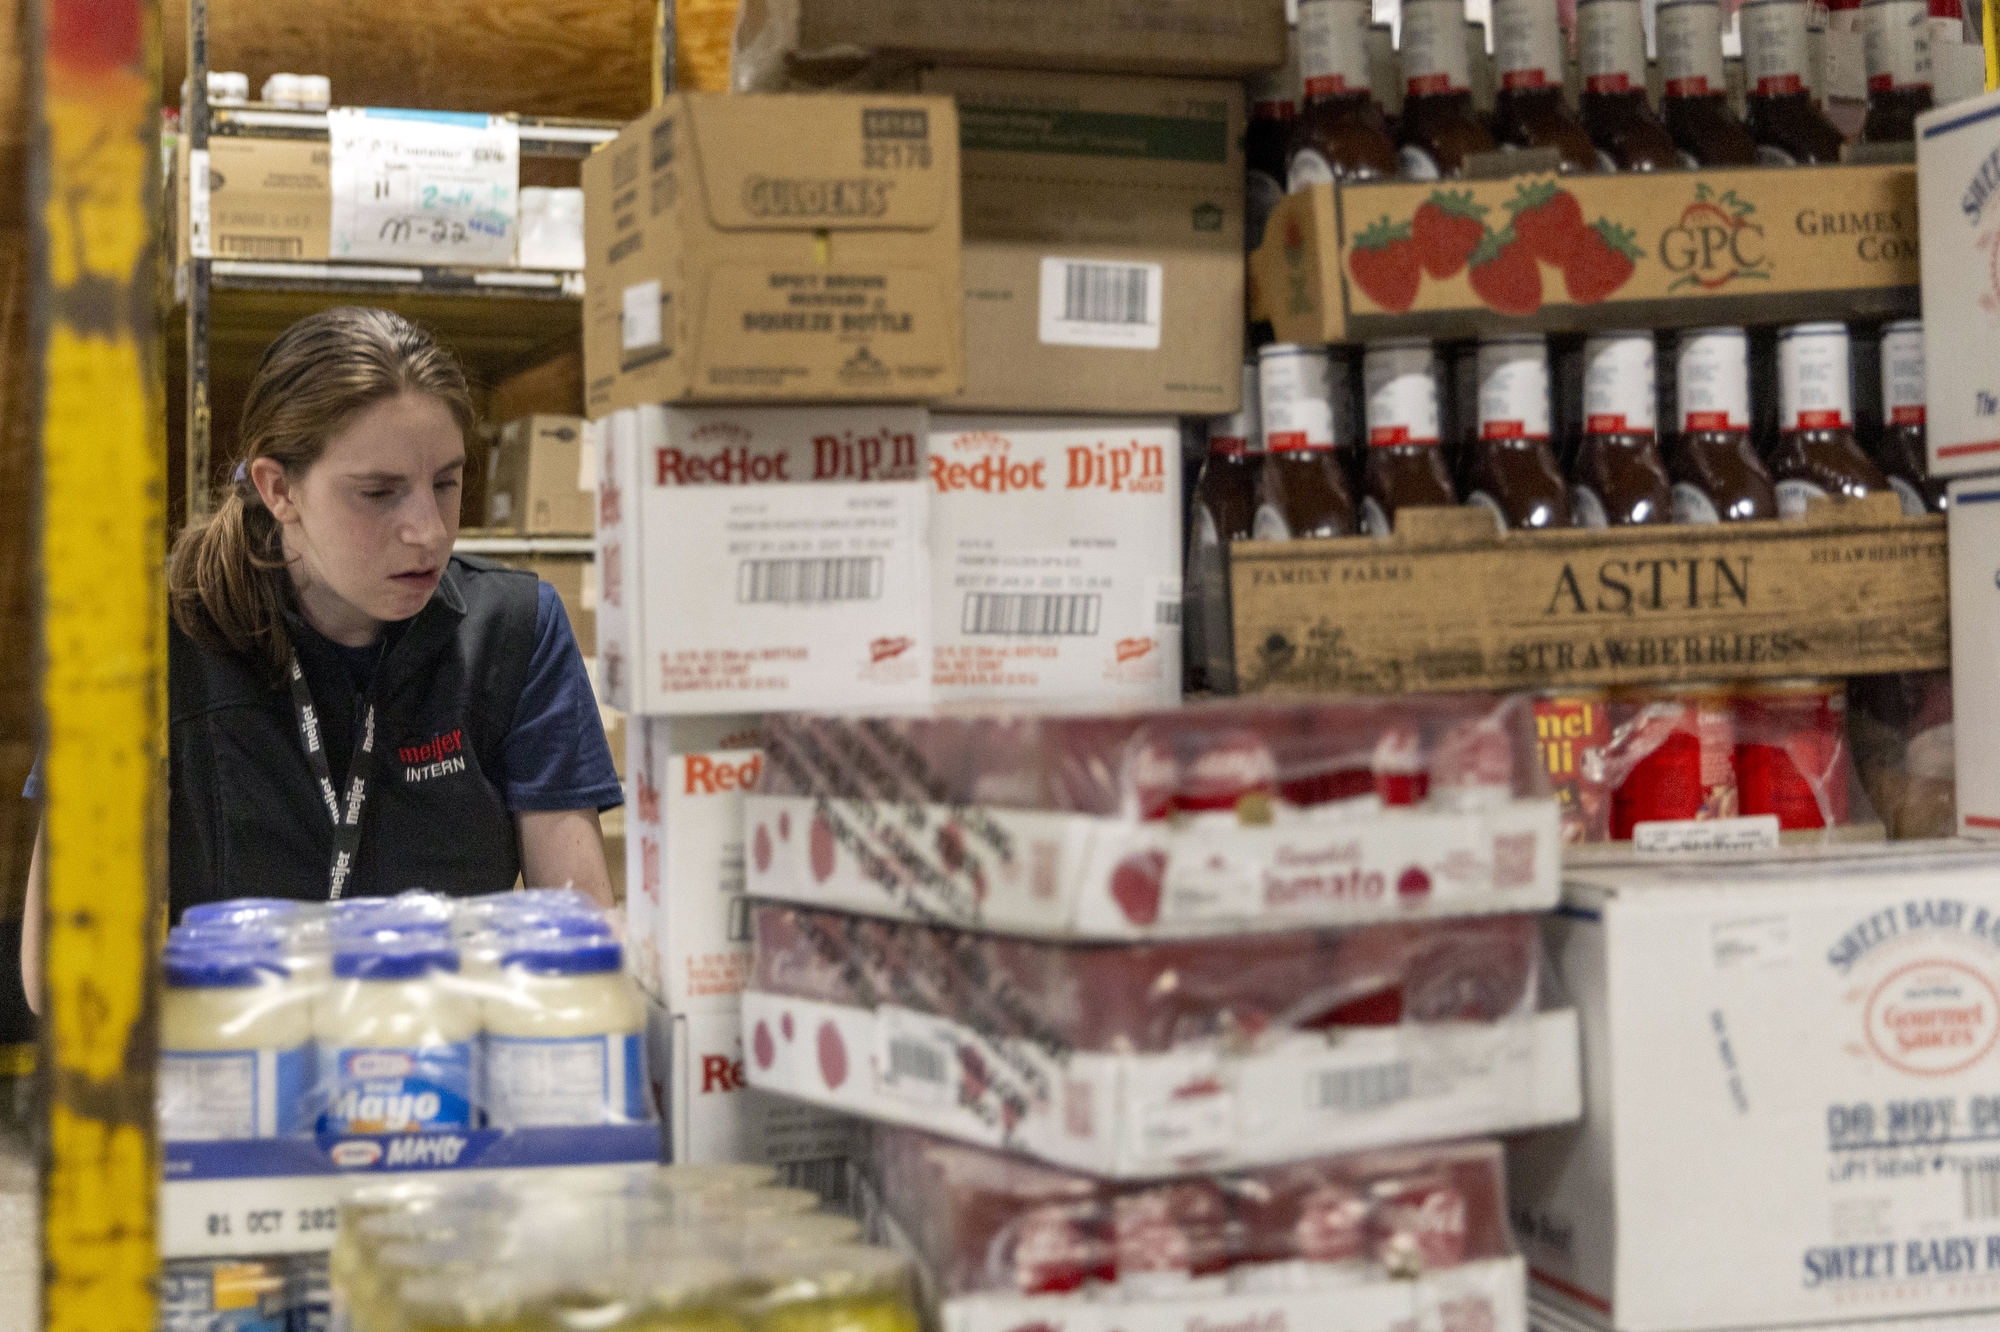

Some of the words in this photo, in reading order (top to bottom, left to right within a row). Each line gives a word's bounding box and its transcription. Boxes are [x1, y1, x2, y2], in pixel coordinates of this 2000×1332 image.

[1795, 208, 1902, 238] GRIMES
[1659, 223, 1766, 274] GPC
[654, 446, 791, 487] RedHot
[811, 426, 918, 482] Dip'n
[929, 454, 1046, 493] RedHot
[1065, 439, 1165, 493] Dip'n
[1251, 566, 1332, 586] FAMILY
[1342, 563, 1415, 583] FARMS
[1545, 555, 1753, 616] ASTIN
[1507, 630, 1796, 674] STRAWBERRIES
[302, 703, 320, 753] meijer
[363, 703, 375, 753] meijer
[399, 728, 462, 763] meijer
[406, 756, 466, 783] INTERN
[684, 754, 761, 796] Red
[320, 776, 341, 825] meijer
[345, 776, 366, 825] meijer
[329, 850, 351, 900] meijer
[386, 1135, 468, 1167] MAYO
[207, 1212, 231, 1237] 01
[246, 1210, 284, 1236] OCT
[299, 1207, 338, 1233] 202
[1803, 1241, 1897, 1289] SWEET
[1905, 1235, 1979, 1276] BABY
